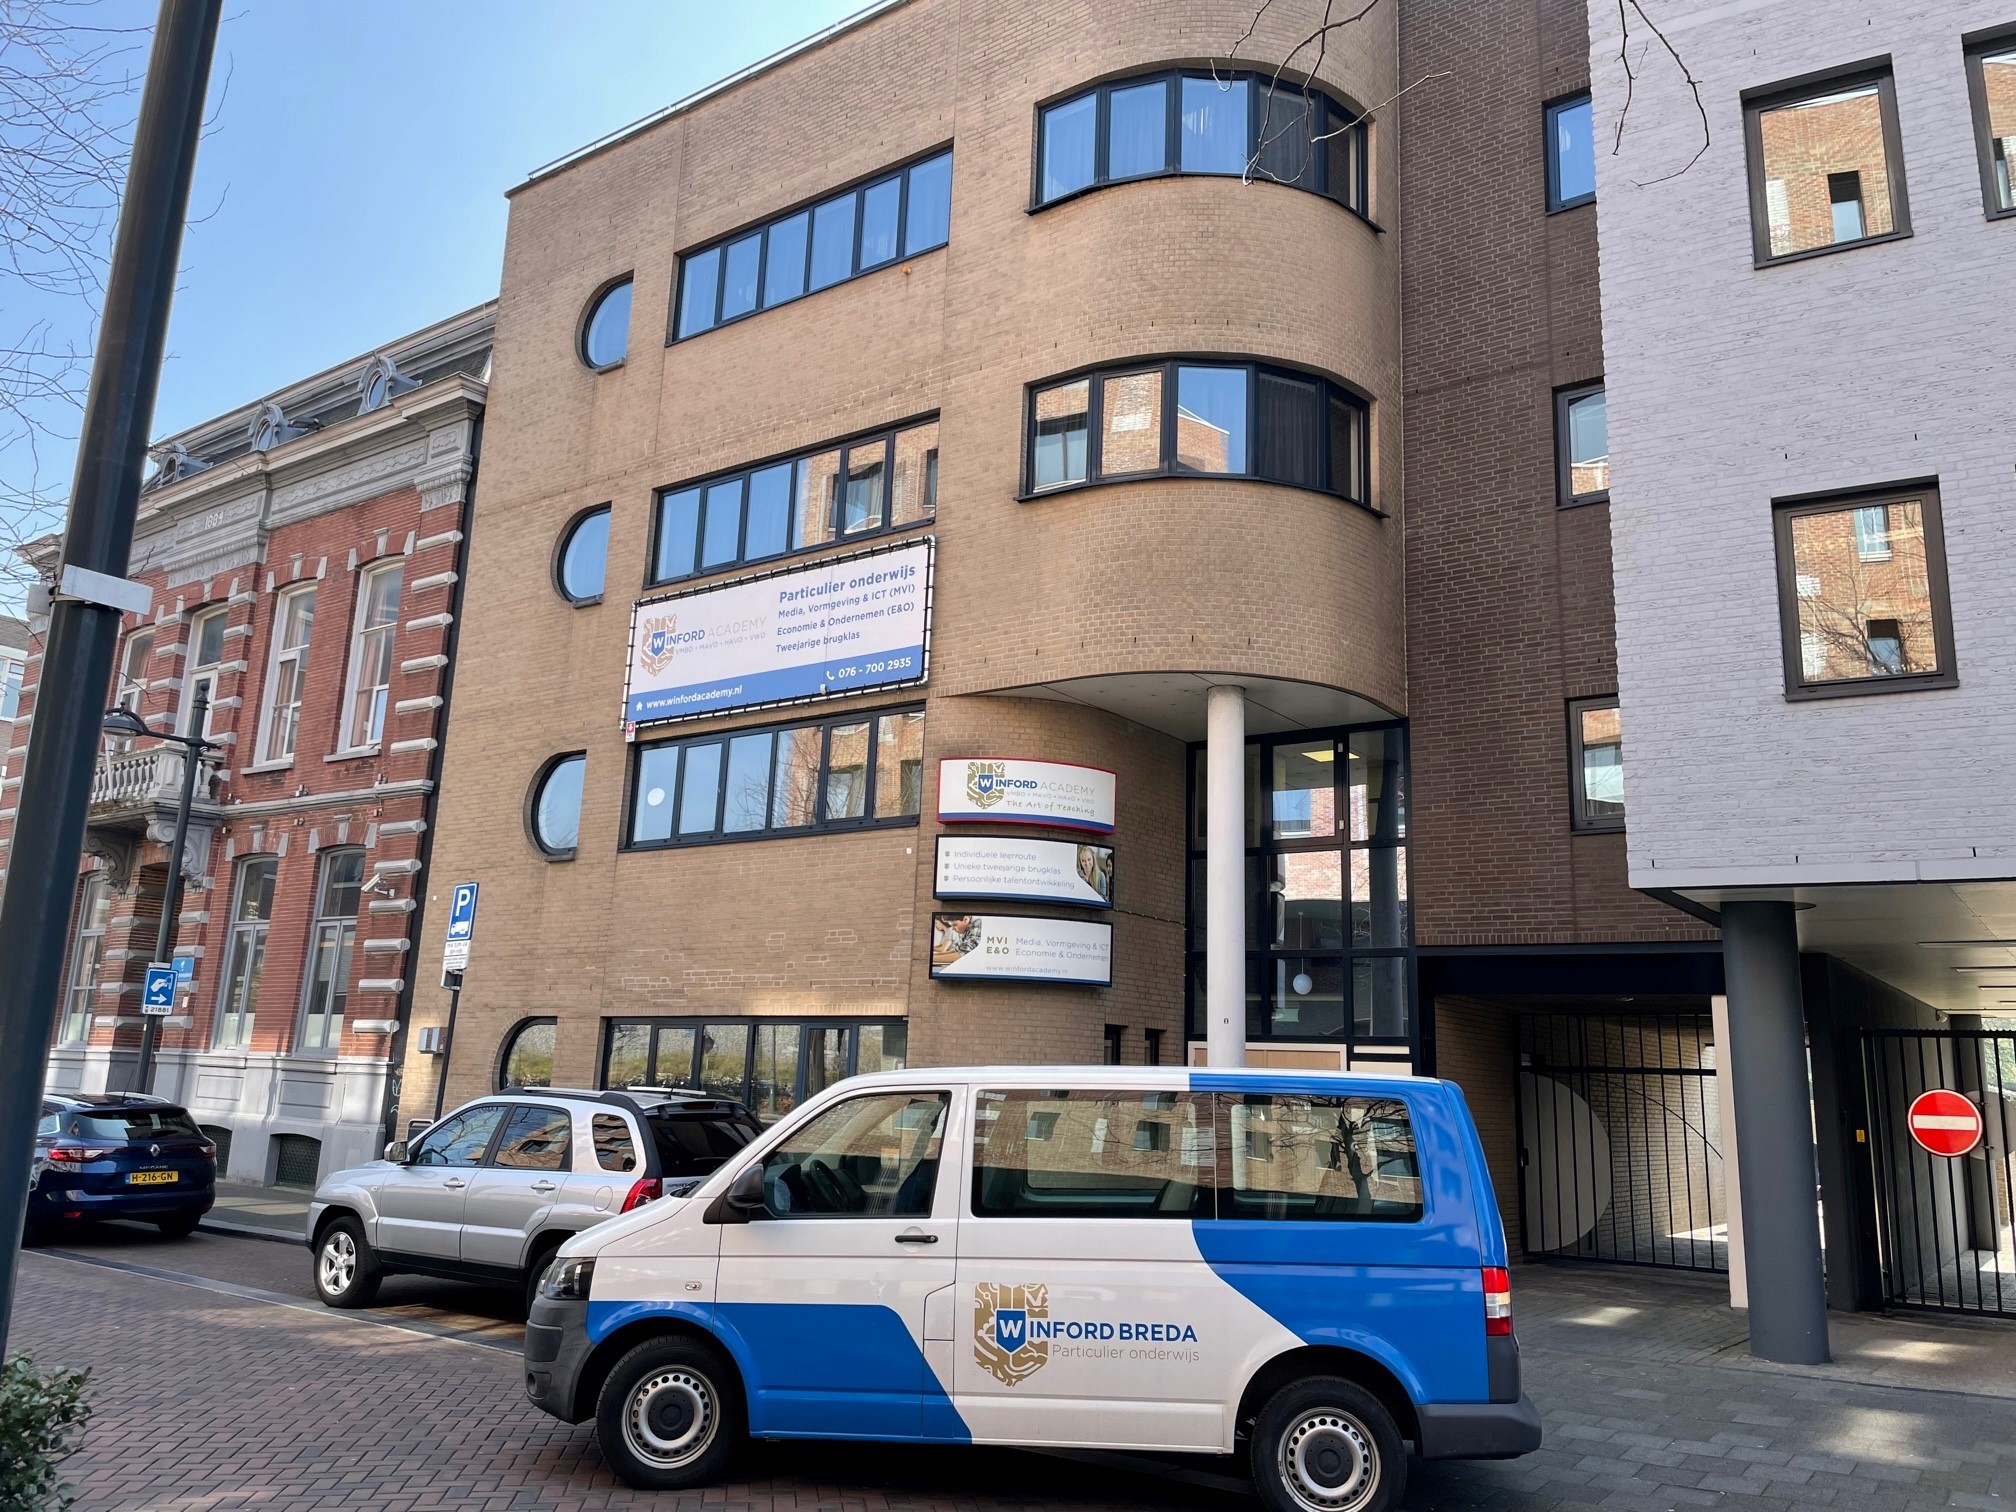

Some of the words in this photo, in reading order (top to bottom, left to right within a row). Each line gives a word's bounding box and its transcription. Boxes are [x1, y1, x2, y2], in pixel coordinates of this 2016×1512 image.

[204, 511, 225, 529] 1884
[779, 581, 846, 603] Particulier
[849, 565, 916, 589] onderwijs
[778, 606, 806, 619] Media,
[808, 595, 860, 613] Vormgeving
[862, 594, 869, 602] &
[871, 589, 887, 601] ICT
[889, 583, 915, 598] (MVI)
[777, 621, 817, 636] Economie
[820, 619, 826, 628] &
[828, 610, 884, 626] Ondernemen
[887, 602, 915, 616] (E&O)
[653, 629, 705, 648] WINFORD
[707, 616, 767, 638] ACADEMY
[675, 646, 694, 655] VMBO
[699, 641, 719, 651] MAVO
[724, 636, 743, 646] HAVO
[750, 632, 766, 641] VWO
[776, 638, 821, 653] Tweejarige
[823, 631, 860, 646] brugklas
[838, 665, 857, 679] 076
[865, 661, 885, 675] 700
[886, 656, 912, 670] 2935
[646, 685, 742, 709] www.winfordacademy.nl
[980, 778, 1038, 790] WINFORD
[1040, 781, 1096, 796] ACADEMY
[1006, 800, 1022, 808] The
[1025, 801, 1041, 809] Art
[1044, 801, 1055, 811] of
[1057, 804, 1095, 817] Teaching
[954, 850, 998, 858] Individuele
[1000, 851, 1037, 861] leerroute
[983, 863, 1025, 873] tweejarige
[1027, 865, 1061, 875] brugklas
[953, 875, 1002, 884] Persoonlijke
[1003, 876, 1075, 889] talentontwikkeling
[456, 889, 470, 916] P
[986, 936, 1008, 944] MVI
[1045, 939, 1091, 951] Vormgeving
[1092, 942, 1098, 950] &
[986, 946, 1009, 955] E&O
[1015, 949, 1057, 958] Economie
[1066, 952, 1109, 962] Ondernemen
[132, 1172, 173, 1183] H-216-GN
[999, 1319, 1115, 1340] WINFORD
[1119, 1323, 1198, 1342] BREDA
[1052, 1344, 1125, 1360] Particulier
[1129, 1348, 1200, 1363] onderwijs
